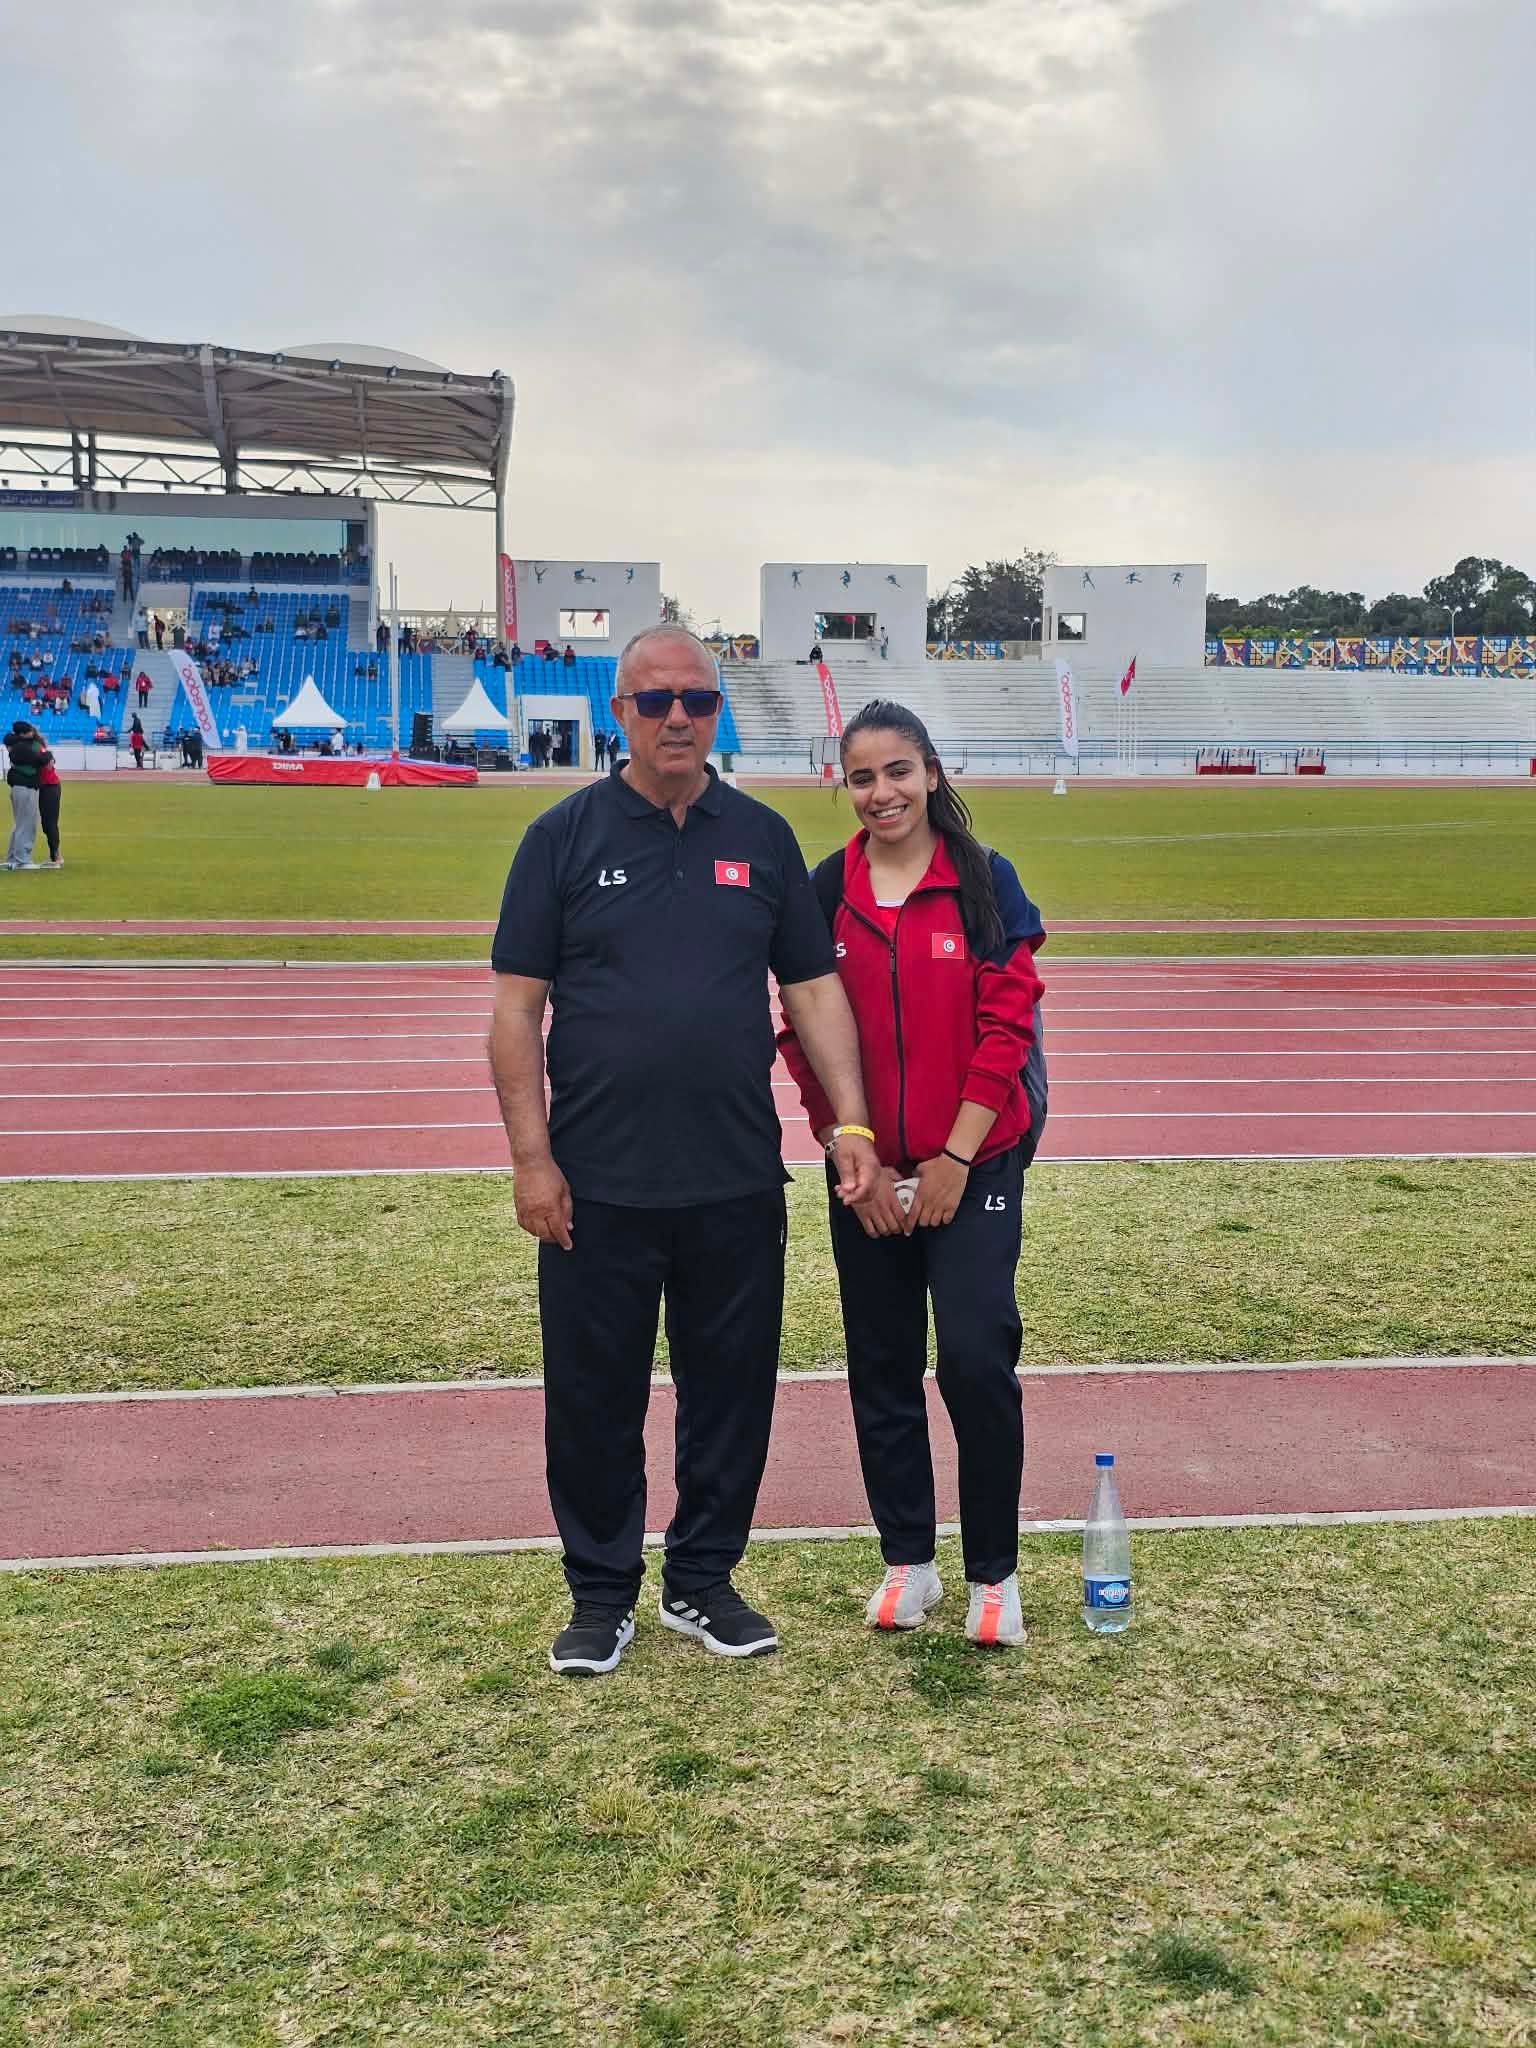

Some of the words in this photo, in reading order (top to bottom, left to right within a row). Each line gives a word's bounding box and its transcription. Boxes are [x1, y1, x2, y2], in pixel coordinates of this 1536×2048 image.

[598, 869, 628, 886] LS
[833, 942, 848, 958] S
[984, 1194, 1006, 1211] LS
